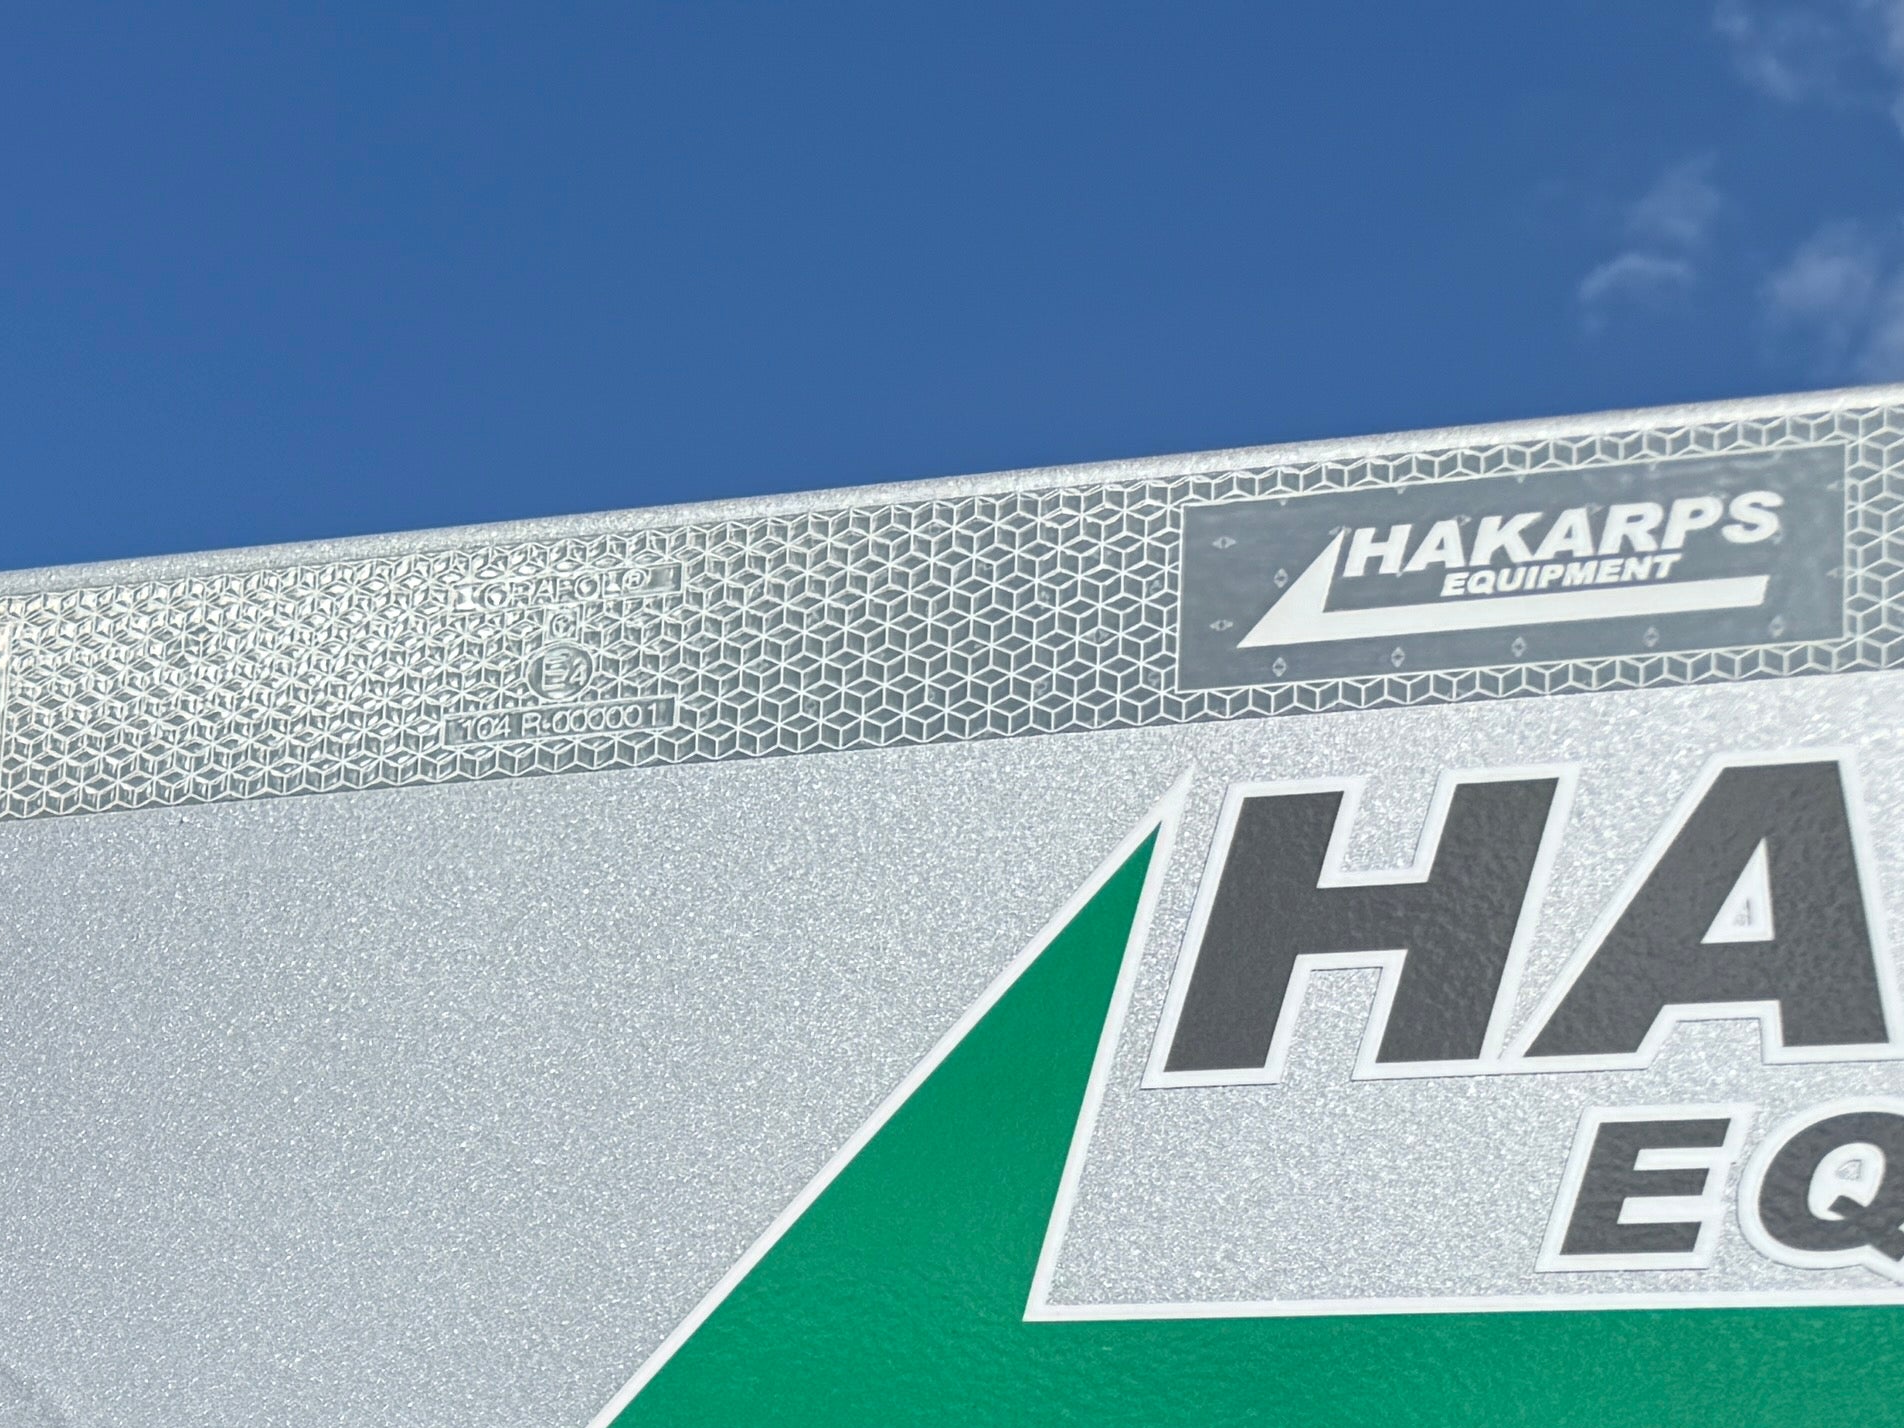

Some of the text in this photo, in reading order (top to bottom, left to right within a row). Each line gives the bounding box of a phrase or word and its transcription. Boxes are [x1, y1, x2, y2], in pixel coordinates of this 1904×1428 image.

[1343, 490, 1785, 577] HAKARPS
[1439, 553, 1683, 597] EQUIPMENT
[462, 715, 512, 739] 104
[1158, 756, 1894, 1075] HA
[1557, 1107, 1904, 1263] EQ
